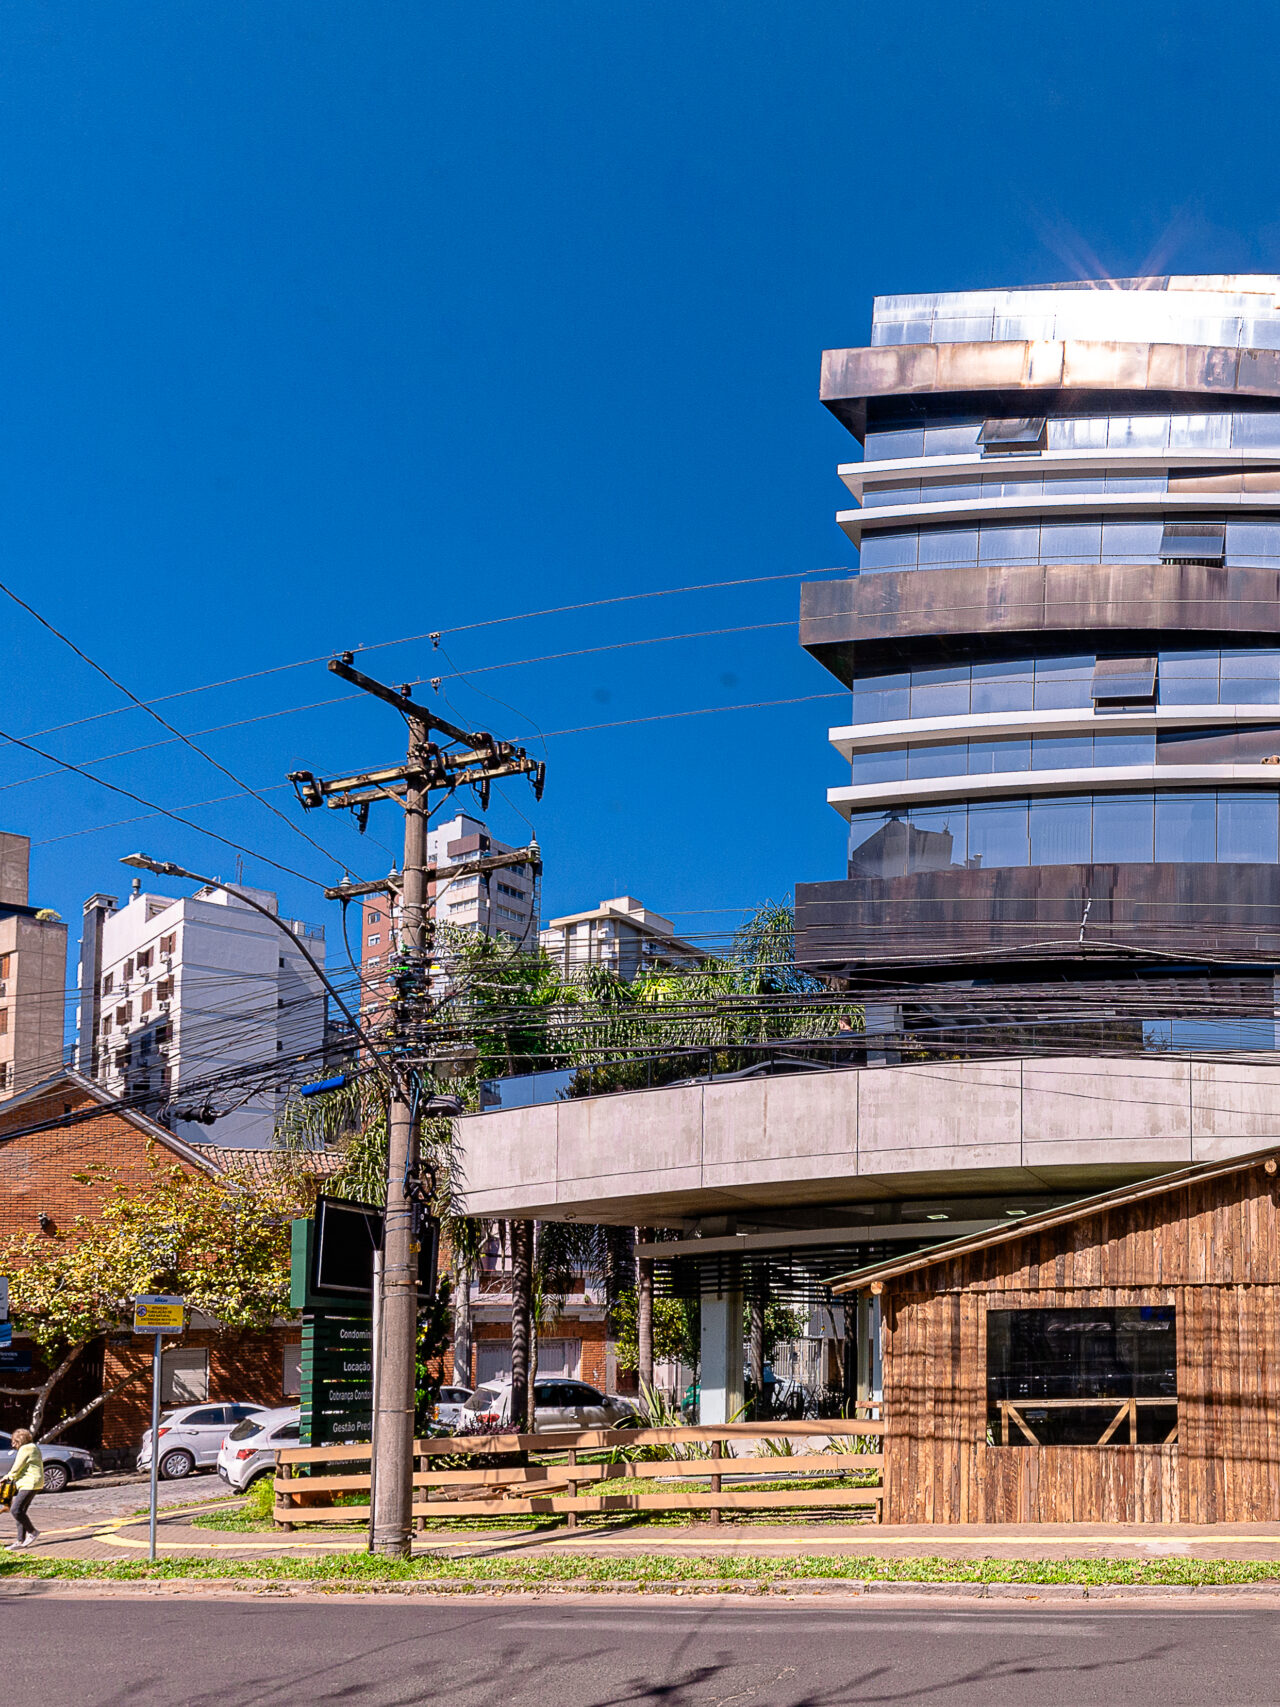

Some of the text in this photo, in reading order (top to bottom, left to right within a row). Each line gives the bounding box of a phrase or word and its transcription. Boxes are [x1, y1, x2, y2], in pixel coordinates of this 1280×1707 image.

[343, 1361, 371, 1373] Locação
[333, 1420, 372, 1432] Gestão Pred
